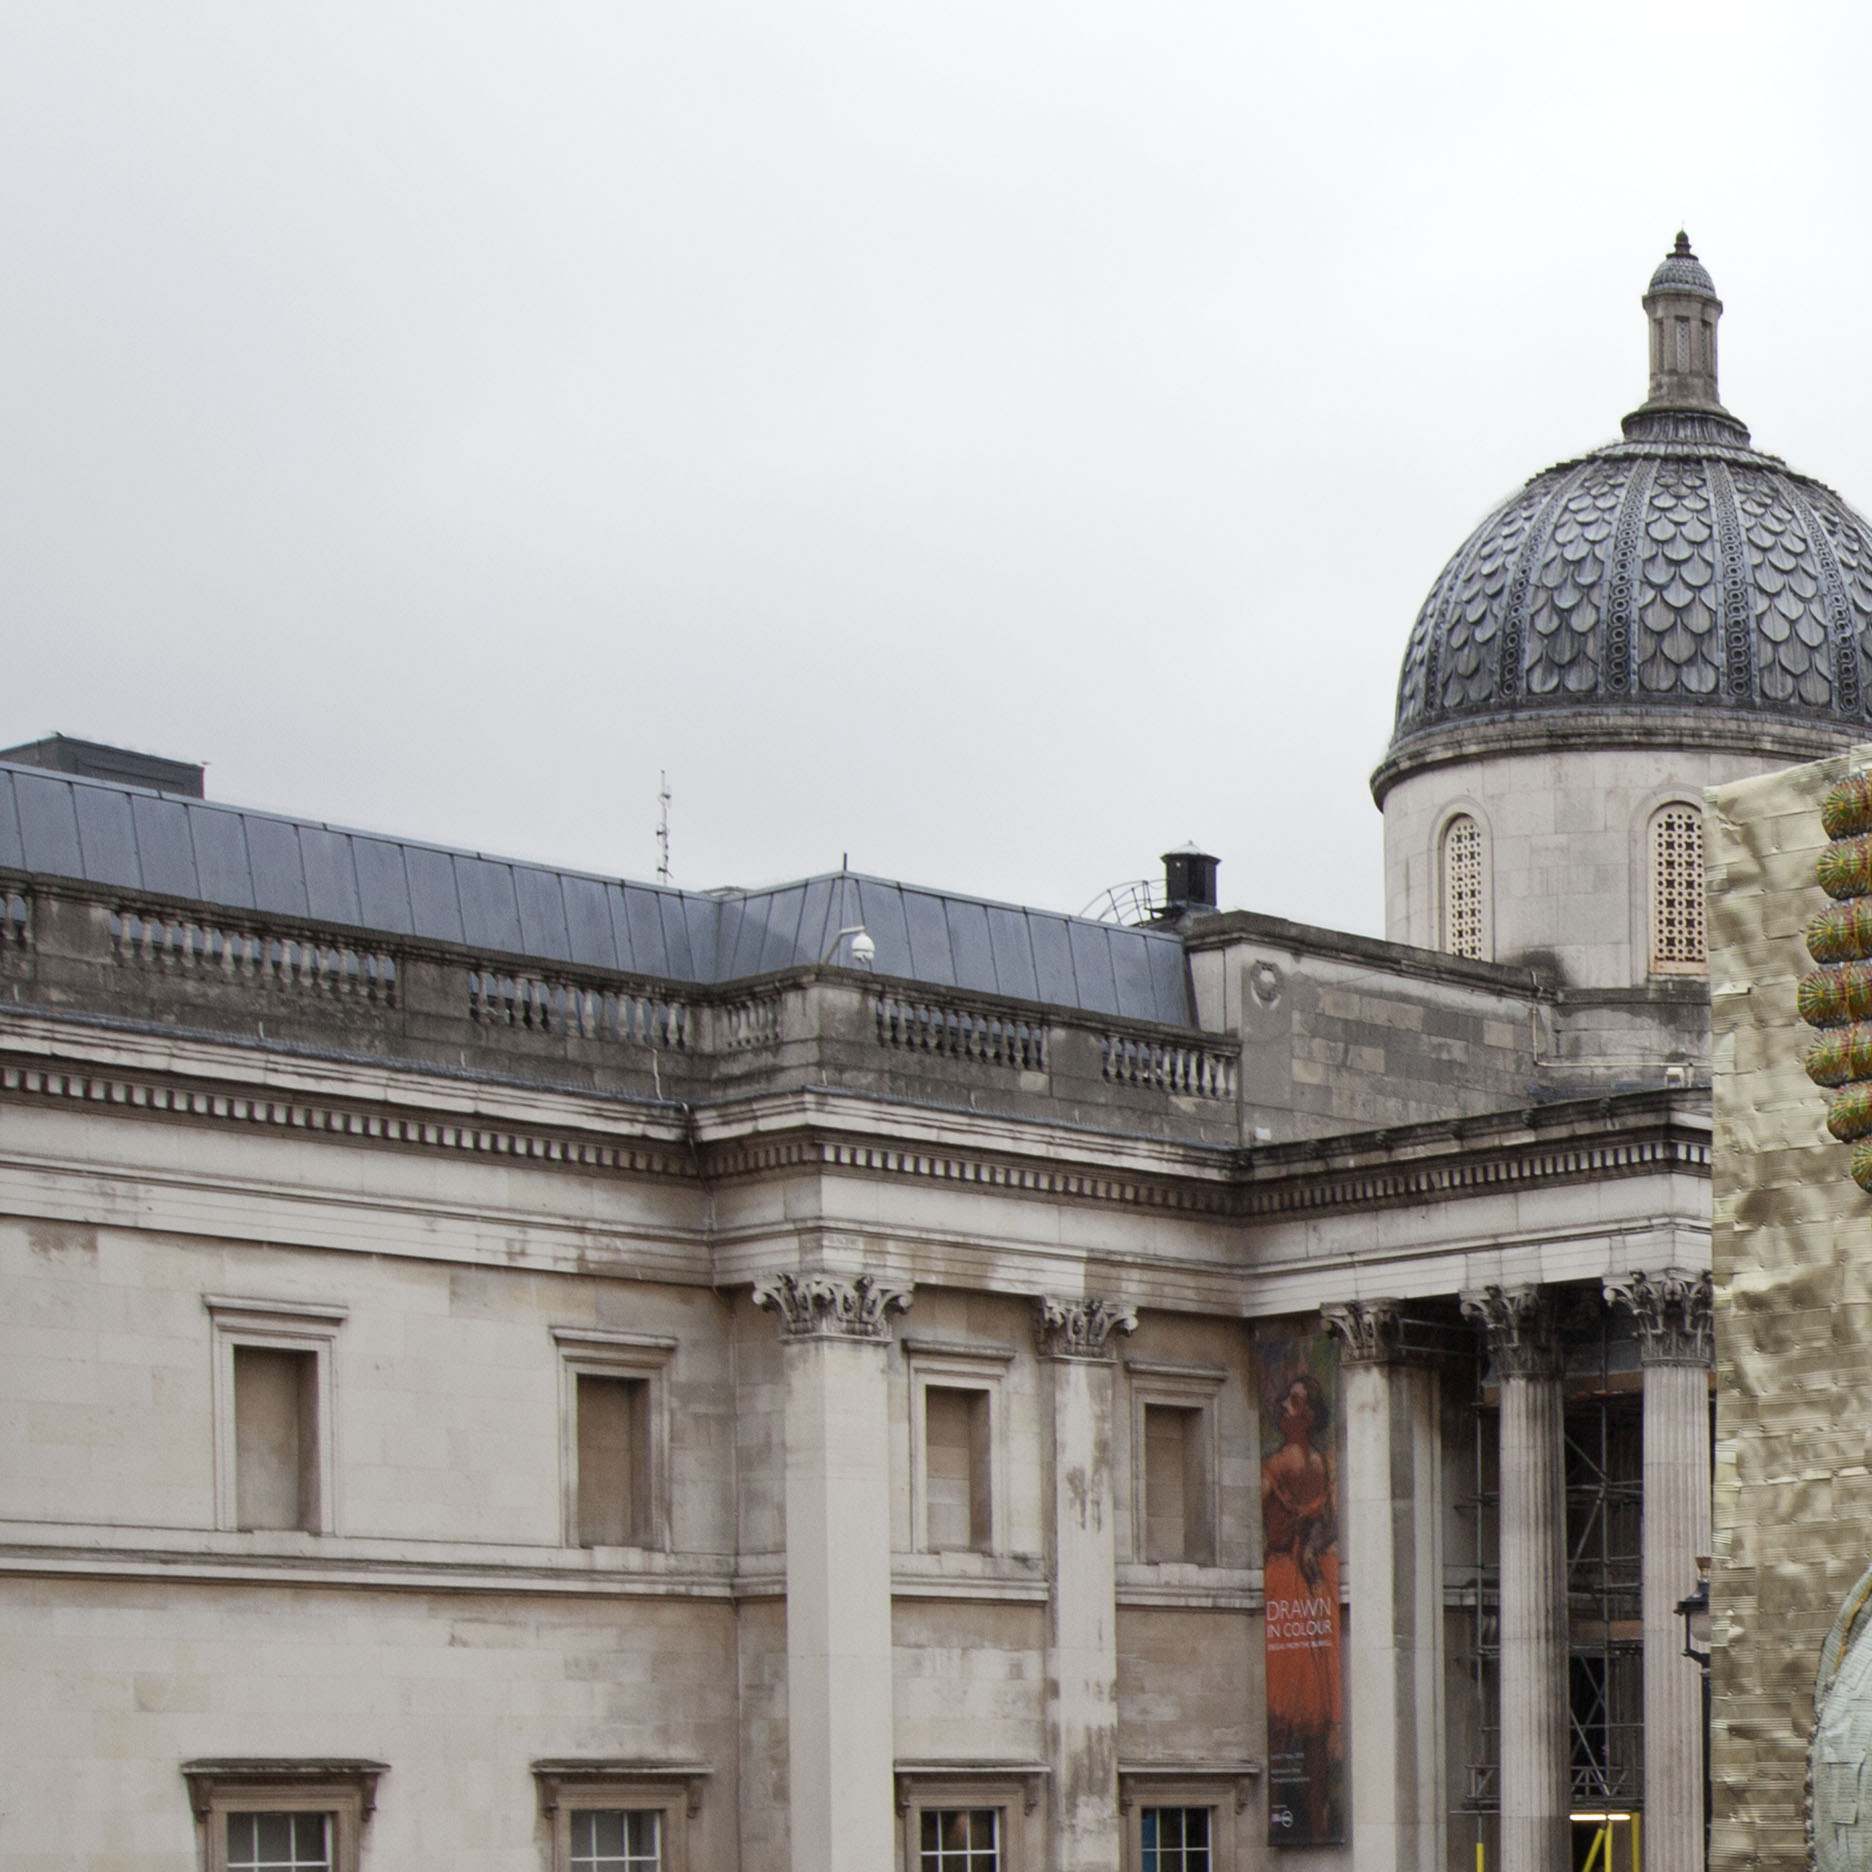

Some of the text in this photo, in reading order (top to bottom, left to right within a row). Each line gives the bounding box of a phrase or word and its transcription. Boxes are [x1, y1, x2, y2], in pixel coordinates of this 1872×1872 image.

[1266, 1597, 1332, 1621] DRAWN
[1267, 1619, 1333, 1638] IN COLOUR
